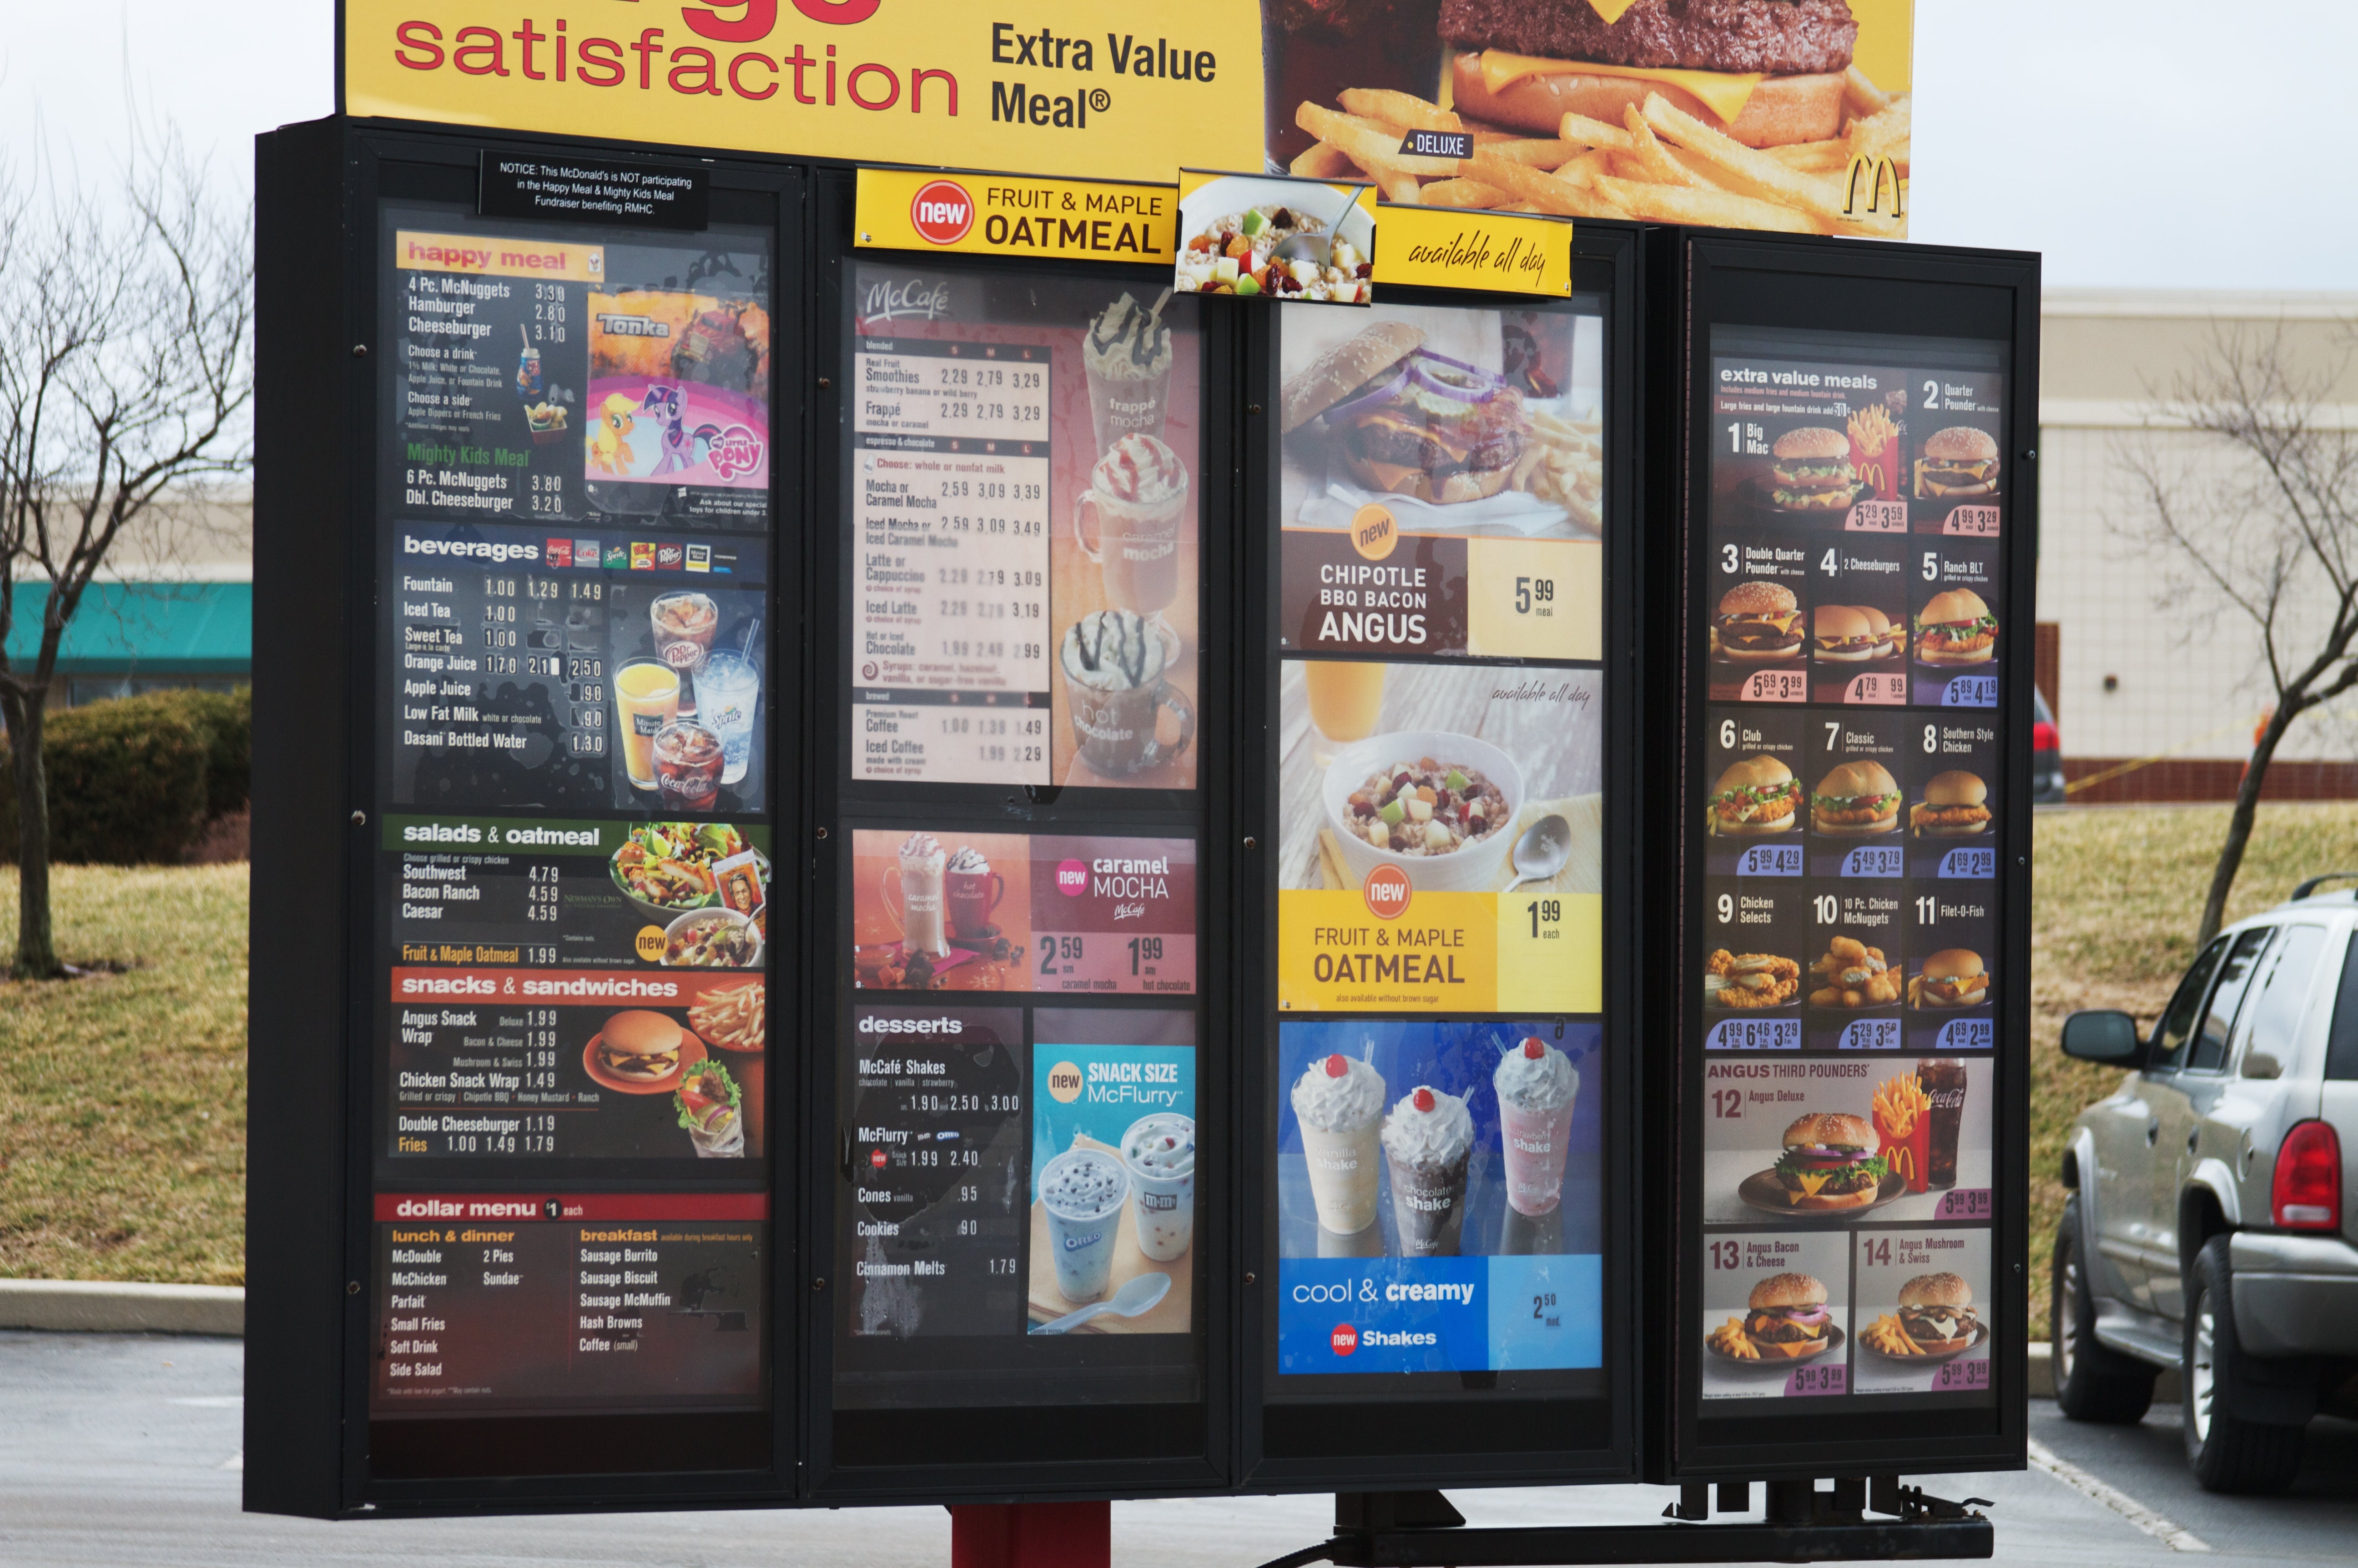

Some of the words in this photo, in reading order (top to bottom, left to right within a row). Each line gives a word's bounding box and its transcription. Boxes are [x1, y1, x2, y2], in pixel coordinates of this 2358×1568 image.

[993, 22, 1093, 71] Extra
[1108, 33, 1216, 83] Value
[395, 19, 958, 117] satisfaction
[1417, 134, 1464, 156] DELUXE
[500, 162, 538, 175] NOTICE:
[541, 166, 558, 177] This
[560, 167, 609, 181] McDonald's
[611, 171, 618, 181] is
[620, 172, 640, 183] NOT
[642, 174, 692, 190] participating
[517, 179, 525, 189] in
[527, 181, 540, 190] the
[543, 181, 569, 195] Happy
[572, 183, 592, 194] Meal
[595, 185, 601, 195] &
[603, 186, 631, 200] Mighty
[634, 188, 651, 199] Kids
[654, 190, 674, 201] Meal
[535, 195, 580, 209] Fundraiser
[582, 198, 622, 214] benefiting
[625, 203, 655, 214] RMHC.
[987, 187, 1054, 210] FRUIT
[1061, 192, 1076, 211] &
[1086, 193, 1163, 216] MAPLE
[919, 201, 966, 225] new
[985, 215, 1161, 255] OATMEAL
[408, 241, 492, 269] happy
[501, 251, 566, 270] meal
[1409, 230, 1490, 270] available
[1494, 237, 1523, 272] all
[1520, 241, 1546, 288] day
[409, 276, 416, 291] 4
[420, 277, 438, 292] Pc.
[441, 278, 510, 300] McNuggets
[409, 296, 475, 317] Hamburger
[409, 316, 492, 339] Cheeseburger
[597, 313, 670, 337] Tonka
[866, 367, 920, 384] Smoothies
[1721, 368, 1768, 383] extra
[1772, 370, 1820, 386] value
[1825, 375, 1877, 390] meals
[1923, 380, 1939, 409] 2
[1945, 383, 1973, 397] Quarter
[866, 401, 901, 418] Frappé
[1945, 398, 1976, 412] Pounder
[1728, 422, 1739, 452] 1
[1747, 423, 1763, 441] Big
[408, 443, 455, 467] Mighty
[461, 445, 490, 465] Kids
[494, 448, 529, 467] Meal
[1747, 440, 1768, 454] Mac
[1359, 518, 1390, 548] new
[404, 535, 539, 562] beverages
[1820, 548, 1838, 577] 4
[1850, 558, 1900, 574] Cheeseburgers
[1944, 560, 1967, 573] Ranch
[1970, 562, 1984, 574] BLT
[404, 576, 453, 593] Fountain
[1320, 564, 1426, 588] CHIPOTLE
[1320, 589, 1358, 607] BBQ
[1364, 590, 1426, 609] BACON
[404, 602, 428, 617] Iced
[431, 603, 451, 618] Tea
[1319, 611, 1426, 644] ANGUS
[1492, 680, 1546, 702] available
[1548, 683, 1569, 703] all
[1568, 685, 1590, 710] day
[404, 705, 427, 719] Low
[431, 706, 449, 721] Fat
[453, 706, 479, 722] Milk
[482, 714, 499, 723] white
[511, 714, 542, 724] chocolate
[404, 730, 443, 746] Dasani
[448, 732, 489, 748] Bottled
[493, 734, 527, 749] Water
[1825, 722, 1840, 751] 7
[1846, 731, 1875, 745] Classic
[1943, 727, 1975, 740] Southern
[1977, 727, 1994, 741] Style
[1943, 740, 1972, 754] Chicken
[403, 823, 481, 843] salads
[488, 826, 499, 844] &
[506, 827, 600, 846] oatmeal
[403, 863, 466, 881] Southwest
[1093, 856, 1169, 876] caramel
[1059, 869, 1085, 886] new
[403, 883, 439, 900] Bacon
[443, 884, 480, 900] Ranch
[1094, 876, 1169, 900] MOCHA
[1371, 882, 1405, 902] new
[1844, 912, 1889, 927] McNuggets
[1915, 895, 1935, 925] 11
[1315, 928, 1370, 946] FRUIT
[1376, 928, 1390, 946] &
[1397, 929, 1465, 947] MAPLE
[1314, 953, 1465, 984] OATMEAL
[402, 975, 496, 995] snacks
[503, 976, 516, 995] &
[523, 977, 678, 997] sandwiches
[1336, 994, 1349, 1002] also
[1350, 994, 1376, 1002] available
[1379, 994, 1401, 1002] without
[1423, 995, 1439, 1004] sugar
[859, 1015, 962, 1034] desserts
[859, 1059, 901, 1075] McCafé
[906, 1059, 946, 1075] Shakes
[1088, 1062, 1142, 1083] SNACK
[1145, 1063, 1178, 1083] SIZE
[1708, 1065, 1770, 1078] ANGUS
[1773, 1065, 1805, 1078] THIRD
[859, 1078, 887, 1087] chocolate
[895, 1078, 915, 1087] vanilla
[922, 1079, 954, 1089] strawberry
[1052, 1073, 1080, 1090] new
[1088, 1085, 1178, 1107] McFlurry
[1712, 1089, 1741, 1118] 12
[1749, 1091, 1774, 1104] Angus
[1778, 1090, 1804, 1101] Deluxe
[858, 1127, 908, 1145] McFlurry
[397, 1200, 464, 1216] dollar
[469, 1203, 536, 1216] menu
[393, 1230, 440, 1242] lunch
[444, 1230, 456, 1242] &
[461, 1230, 515, 1242] dinner
[1900, 1238, 1922, 1251] Angus
[1925, 1237, 1965, 1251] Mushroom
[580, 1248, 621, 1265] Sausage
[624, 1248, 658, 1262] Burrito
[1864, 1238, 1892, 1266] 14
[1293, 1278, 1352, 1303] cool
[1359, 1278, 1379, 1302] &
[1386, 1283, 1475, 1305] creamy
[1333, 1333, 1355, 1346] new
[1362, 1331, 1436, 1346] Shakes
